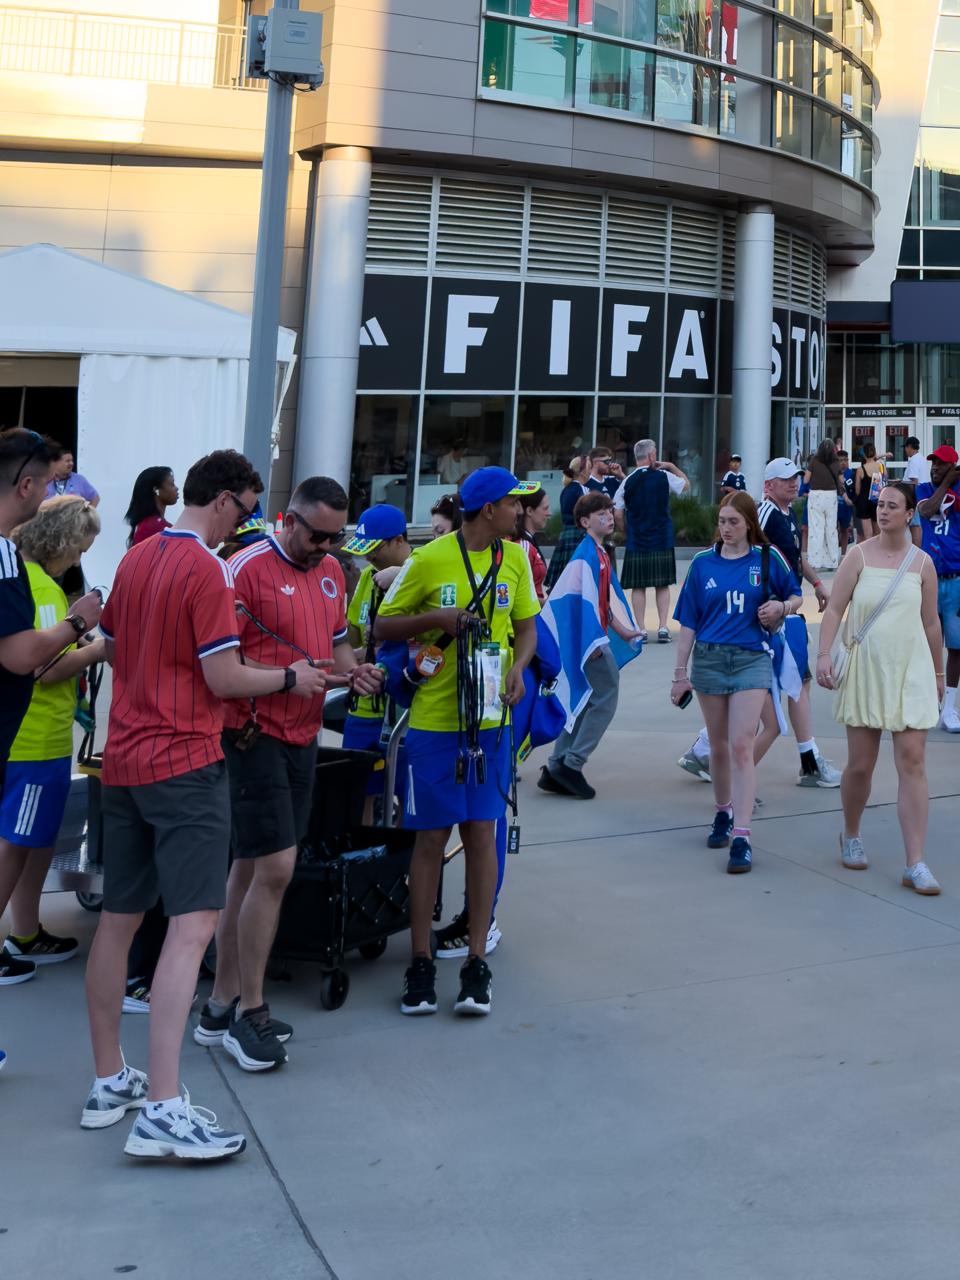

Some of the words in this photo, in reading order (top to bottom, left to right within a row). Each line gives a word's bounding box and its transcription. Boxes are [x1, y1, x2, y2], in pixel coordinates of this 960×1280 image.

[443, 294, 709, 380] FIFA
[771, 321, 824, 391] STO
[855, 427, 871, 437] EXIT
[934, 519, 950, 536] 21
[726, 589, 745, 614] 14
